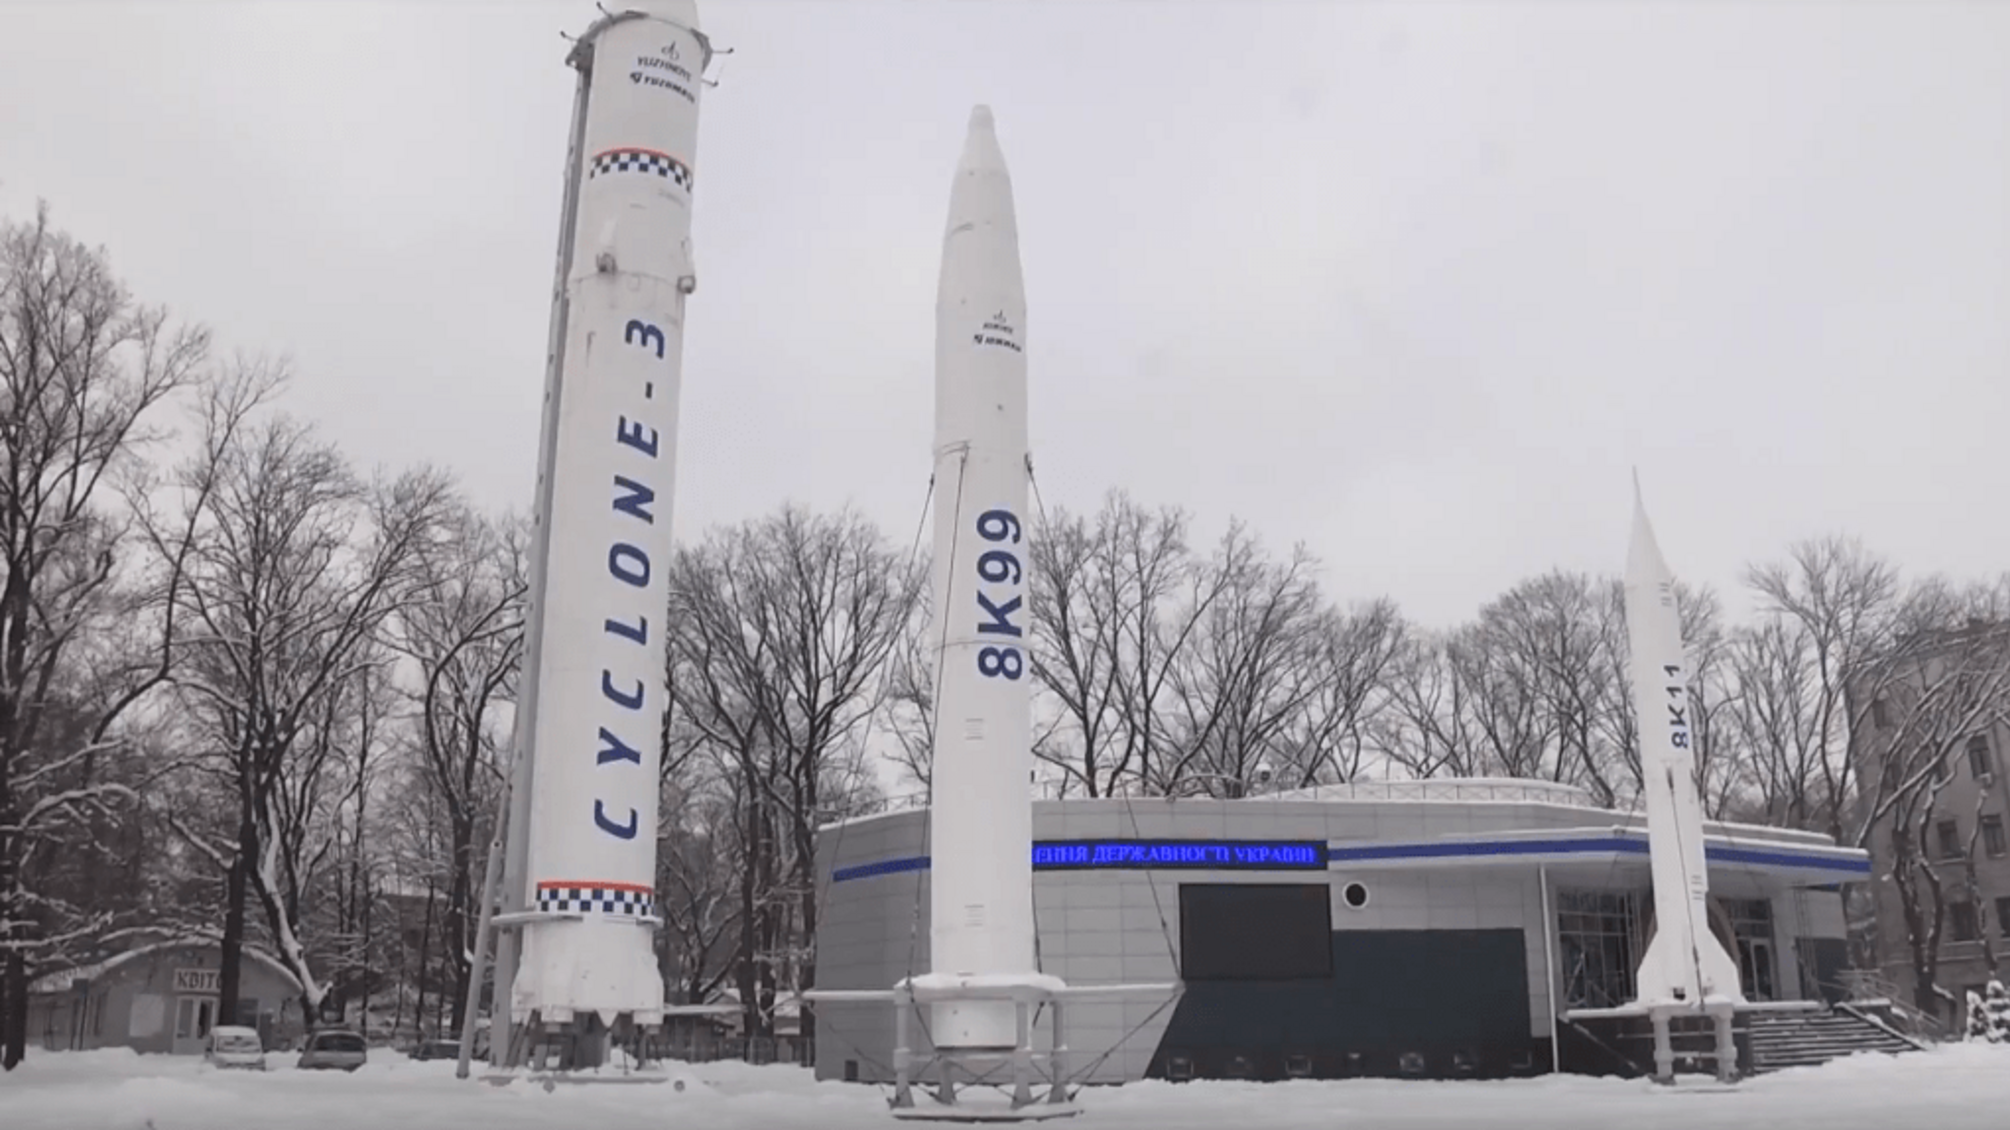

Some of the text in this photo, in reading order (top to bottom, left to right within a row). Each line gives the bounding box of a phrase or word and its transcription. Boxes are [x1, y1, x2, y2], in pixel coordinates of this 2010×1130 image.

[594, 319, 666, 840] CYCLONE-3
[976, 509, 1023, 681] 8K99
[1663, 664, 1688, 749] 8K11
[1032, 846, 1087, 862] ЕННЯ
